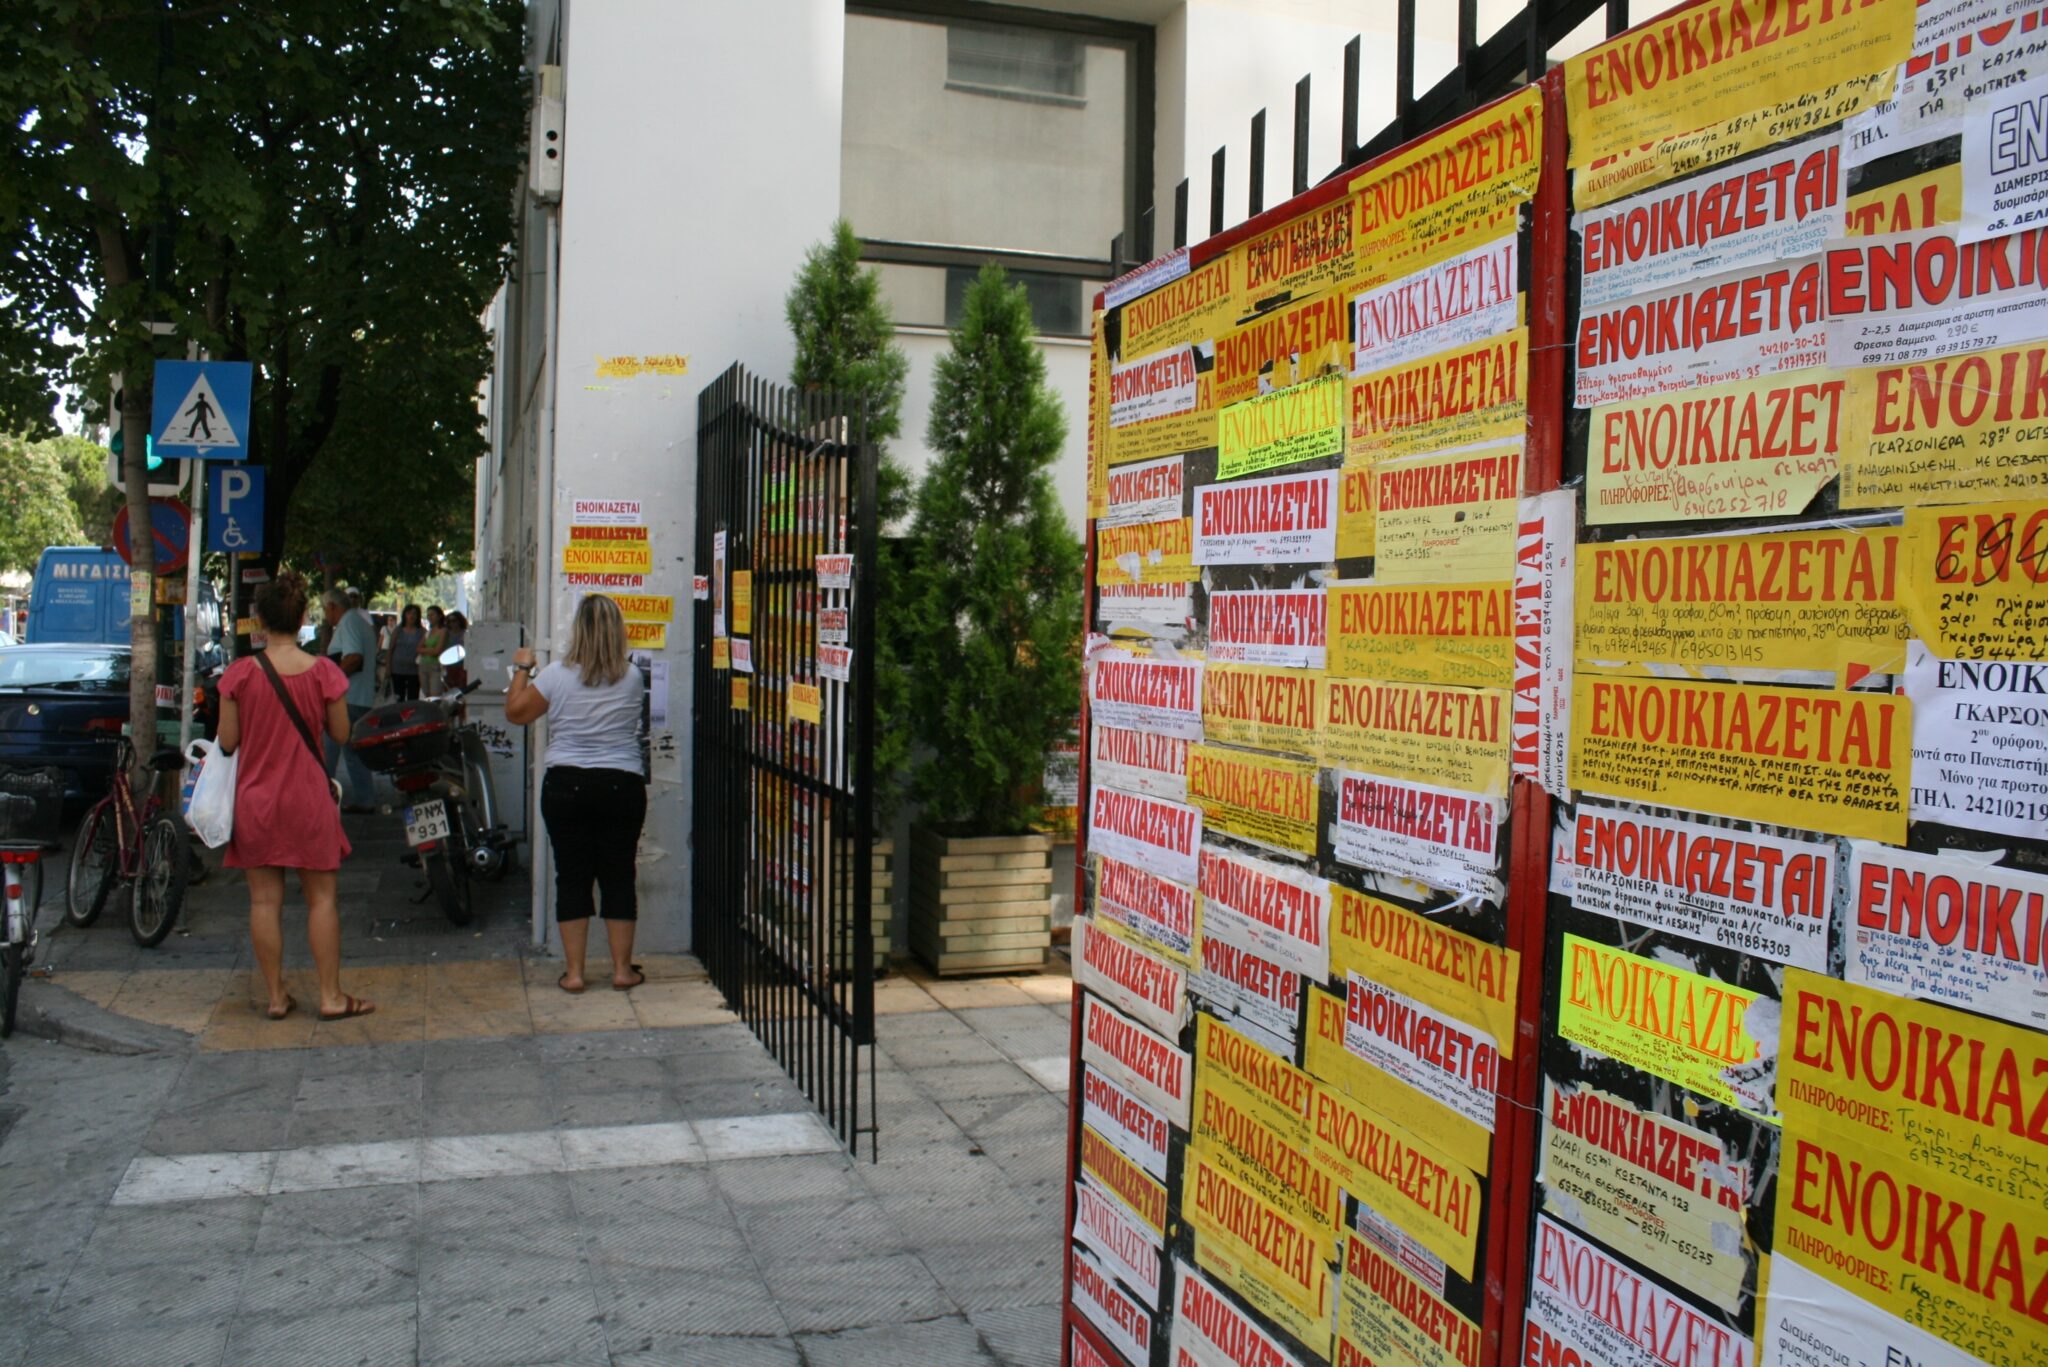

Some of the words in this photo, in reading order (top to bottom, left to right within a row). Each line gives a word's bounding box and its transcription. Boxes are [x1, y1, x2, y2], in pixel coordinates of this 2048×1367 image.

[1358, 104, 1536, 235] ΕΝΟΙΚΙΑΖΕΤΑΙ
[1850, 124, 1890, 151] ΤΗΛ.
[1587, 156, 1657, 193] ΠΛΗΡΟΦΟΡΙΕΣ
[1583, 144, 1840, 275] ΕΝΟΙΚΙΑΖΕΤΑΙ
[1247, 200, 1355, 290] ΕΝΟΙΚΙΑΖΕΤ
[1128, 259, 1231, 339] ΕΝΟΙΚΙΑΖΕΤΑΙ
[1359, 244, 1513, 353] ΕΝΟΙΚΙΑΖΕΤΑΙ
[1578, 261, 1825, 370] ΕΝΟΙΚΙΑΖΕΤΑ
[1898, 317, 1951, 333] Διαμερισμα
[1952, 314, 1963, 324] σε
[1964, 307, 1995, 322] αριστη
[1216, 292, 1345, 385] ΕΝΟΙΚΙΑΖΕΤΑΙ
[1853, 339, 1894, 352] Φρεσκο
[1862, 353, 1881, 364] 699
[1883, 352, 1895, 362] 71
[1897, 350, 1910, 361] 08
[1911, 347, 1928, 359] 779
[1935, 344, 1947, 355] 69
[1947, 342, 1959, 353] 39
[1961, 340, 1972, 351] 15
[1973, 338, 1985, 349] 79
[1986, 335, 1998, 346] 72
[1110, 348, 1195, 405] ΕΝΟΙΚΙΑΖΕΤΑΙ
[1351, 340, 1519, 439] ΕΝΟΙΚΙΑΖΕΤΑΙ
[1222, 382, 1337, 456] ΕΝΟΙΚΙΑΖΕΤΑΙ
[1602, 380, 1847, 474] ΕΝΟΙΚΙΑΖΕΤ
[220, 471, 251, 514] P
[575, 501, 641, 514] ΕΝΟΙΚΙΑΖΕΤΑΙ
[1108, 461, 1182, 506] ΝΟΙΚΙΑΖΕΤΑΙ
[1201, 477, 1329, 537] ΕΝΟΙΚΙΑΖΕΤΑΙ
[1378, 453, 1520, 512] ΕΝΟΙΚΙΑΖΕΤΑΙ
[1600, 484, 1673, 506] ΠΛΗΡΟΦΟΡΙΕΣ:
[53, 563, 131, 579] ΜΙΓΔΙΣΙ
[565, 549, 647, 566] ΕΝΟΙΚΙΑΖΕΤΑΙ
[1101, 515, 1192, 561] ΕΝΟΙΚΙΑΖΕΤΑ
[1593, 536, 1899, 604] ΕΝΟΙΚΙΑΖΕΤΑΙ
[567, 572, 643, 587] ΕΝΟΙΚΙΑΖΕΤΑΙ
[612, 597, 669, 614] ΚΙΑΖΕΤΑΙ
[1339, 588, 1512, 637] ΕΝΟΙΚΙΑΖΕΤΑΙ
[1210, 593, 1328, 647] ΕΝΟΙΚΙΑΖΕΤΑΙ
[1095, 660, 1196, 712] ΕΝΟΙΚΙΑΖΕΤΑΙ
[1203, 669, 1315, 730] ΝΟΙΚΙΑΖΕΤΑΙ
[1328, 683, 1501, 744] ΕΝΟΙΚΙΑΖΕΤΑΙ
[1097, 725, 1188, 777] ΕΝΟΙΚΙΑΖΕΤΑ
[1590, 682, 1897, 770] ΕΝΟΙΚΙΑΖΕΤΑΙ
[1944, 752, 1967, 765] στο
[1991, 733, 2048, 754] ορόφου,
[1192, 754, 1312, 822] ΕΝΟΙΚΙΑΖΕΤΑΙ
[1911, 787, 1957, 810] ΤΗΛ.
[1939, 769, 1974, 786] Μόνο
[1978, 776, 1998, 790] για
[417, 819, 449, 839] 931
[1093, 788, 1195, 856] ΕΝΟΙΚΙΑΖΕΤΑΙ
[1340, 777, 1493, 854] ΕΝΟΙΚΙΑΖΕΤΑΙ
[1099, 856, 1196, 938] ΕΝΟΙΚΙΑΖΕΤΑΙ
[1199, 849, 1321, 946] ΕΝΟΙΚΙΑΖΕΤΑΙ
[1574, 813, 1828, 920] ΕΝΟΙΚΙΑΖΕΤΑΙ
[1582, 867, 1659, 896] ΓΚΑΡΣΟΝΙΕΡΑ
[1341, 893, 1509, 1003] ΕΝΟΙΚΙΑΖΕΤΑΙ
[1856, 861, 2048, 967] ΕΝΟΙΚΙ
[1083, 921, 1179, 1015] ΕΝΟΙΚΙΑΖΕΤΑΙ
[1202, 935, 1299, 1011] ΝΟΙΚΙΑΖΕΤΑΙ
[1347, 980, 1499, 1095] ΕΝΟΙΚΙΑΖΕΤΑΙ
[1568, 943, 1749, 1064] ΕΝΟΙΚΙΑΖΕ
[1087, 1000, 1184, 1100] ΕΝΟΙΚΙΑΖΕΤΑΙ
[1206, 1021, 1315, 1120] ΕΝΟΙΚΙΑΖΕΤ
[1085, 1071, 1168, 1154] ΕΝΟΙΚΙΑΖΕΤΑΙ
[1788, 1077, 1894, 1134] ΠΛΗΡΟΦΟΡΙΕΣ:
[1082, 1129, 1167, 1236] ΕΝΟΙΚΙΑΖΕΤΑΙ
[1202, 1088, 1331, 1214] ΕΝΟΙΚΙΑΖΕΤΑΙ
[1315, 1091, 1473, 1238] ΕΝΟΙΚΙΑΖΕΤΑΙ
[1196, 1161, 1317, 1291] ΕΝΟΙΚΙΑΖΕΤΑΙ
[1671, 1194, 1691, 1214] 123
[1080, 1187, 1160, 1290] ΕΝΟΙΚΙΑΖΕΤΑΙ
[1787, 1226, 1894, 1295] ΠΛΗΡΟΦΟΡΙΕΣ:
[1073, 1253, 1148, 1351] ΕΝΟΙΚΙΑΖΕΤΑΙ
[1346, 1234, 1480, 1367] ΕΝΟΙΚΙΑΖΕΤΑΙ
[1536, 1222, 1750, 1367] ΕΝΟΙΚΙΑΖΕΤΑ
[1779, 1317, 1850, 1367] Διαμέρισμα
